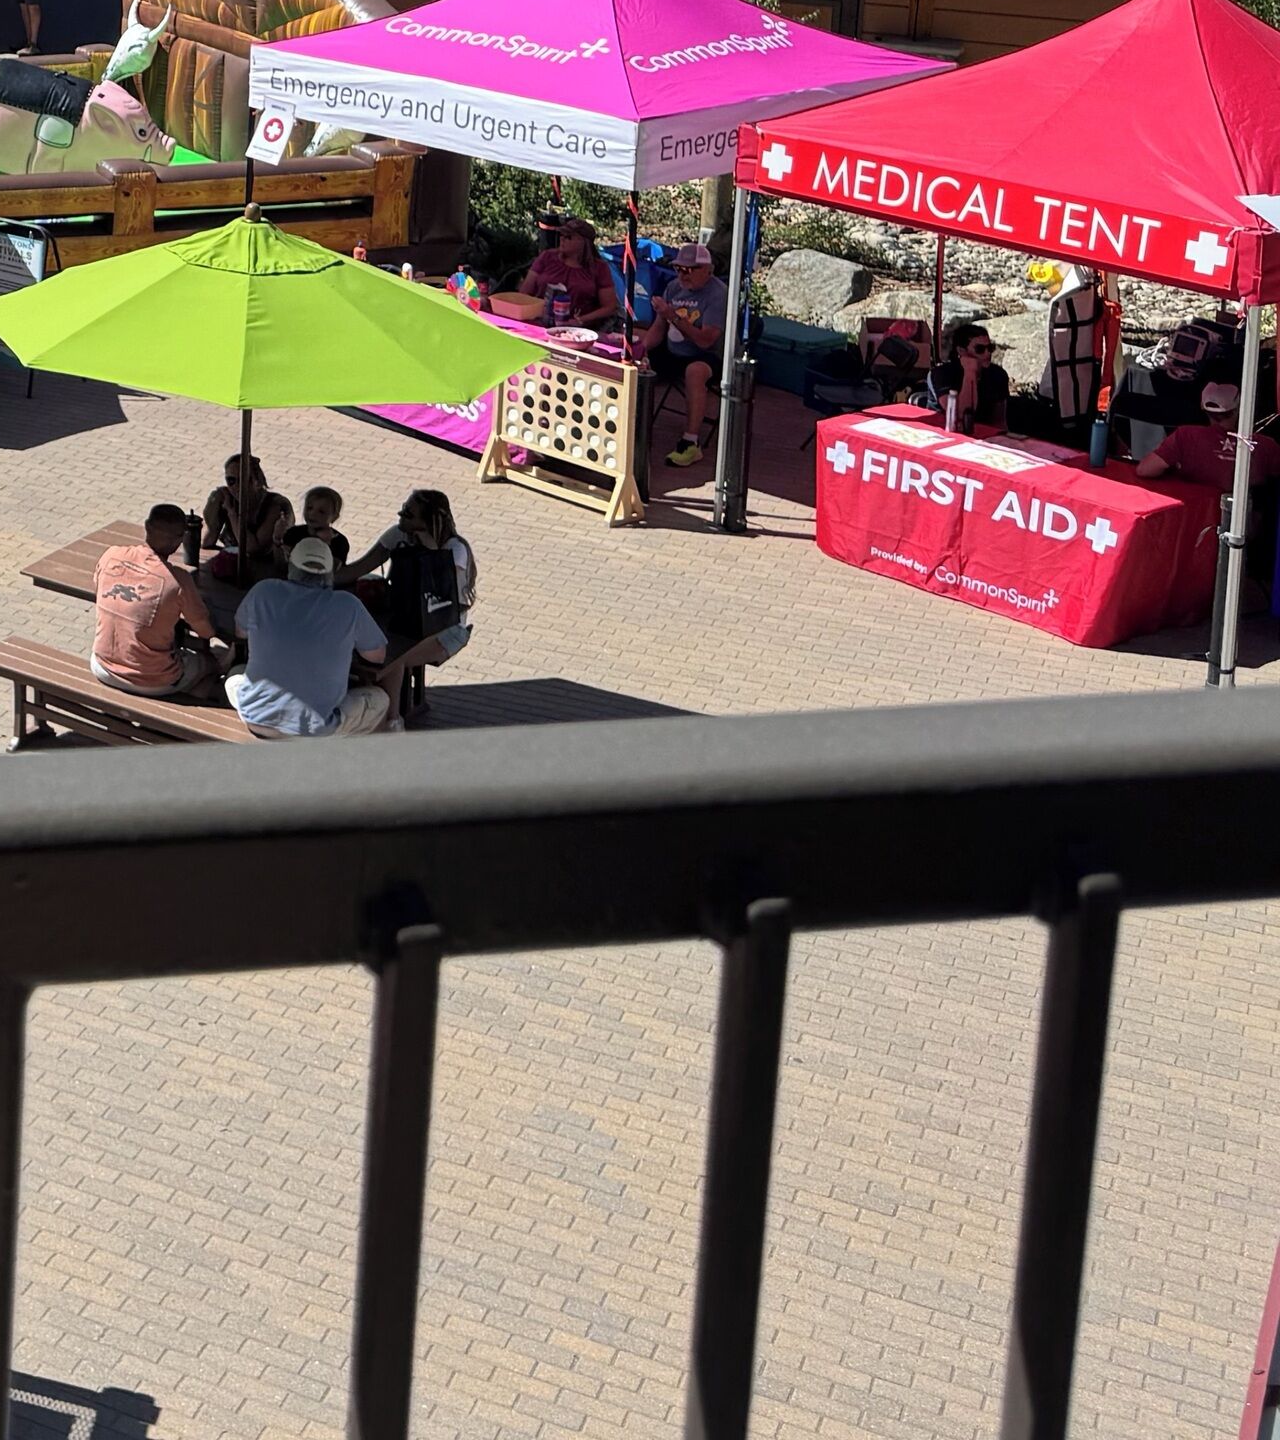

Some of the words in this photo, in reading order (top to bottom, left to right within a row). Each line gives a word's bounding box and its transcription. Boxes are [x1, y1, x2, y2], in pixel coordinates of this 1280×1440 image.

[386, 17, 578, 65] CommonSpirit
[630, 28, 794, 72] CommonSpirit
[270, 68, 394, 119] Emergency
[401, 99, 445, 123] and
[454, 105, 538, 144] Urgent
[546, 124, 607, 160] Care
[811, 151, 1014, 233] MEDICAL
[1033, 194, 1161, 262] TENT
[861, 449, 983, 513] FIRST
[991, 491, 1078, 542] AID
[870, 546, 913, 569] Provided
[934, 565, 1048, 614] CommonSpirit
